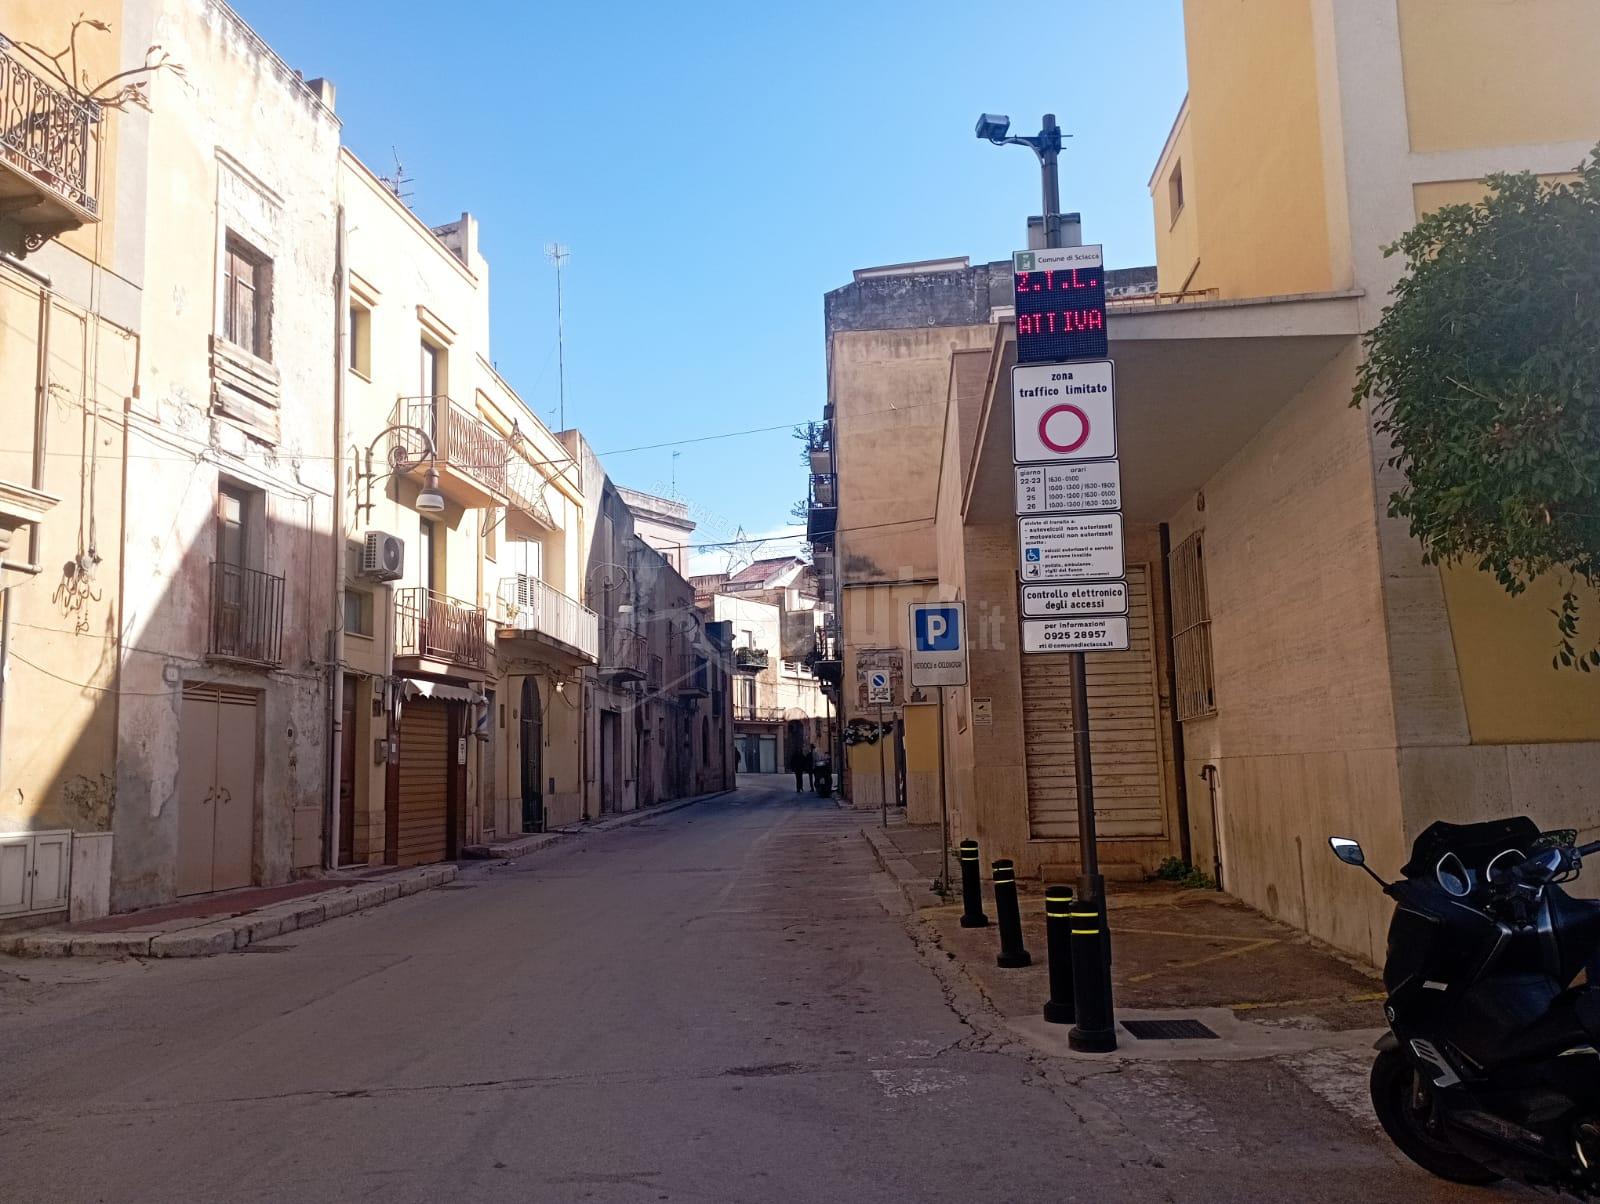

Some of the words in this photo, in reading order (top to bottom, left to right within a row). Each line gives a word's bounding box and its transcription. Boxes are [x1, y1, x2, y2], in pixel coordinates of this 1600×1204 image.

[1038, 256, 1065, 264] Comune
[1075, 253, 1099, 261] Sciacca
[1018, 310, 1102, 334] ATTIVA
[1051, 372, 1074, 382] zona
[1019, 387, 1059, 398] traffico
[1065, 384, 1108, 395] limitato
[1026, 590, 1068, 600] controllo
[1072, 588, 1122, 598] elettronico
[1045, 600, 1068, 610] degli
[1070, 599, 1105, 609] accessi
[927, 615, 947, 645] P
[1044, 632, 1071, 640] 0925
[1074, 630, 1107, 639] 28957
